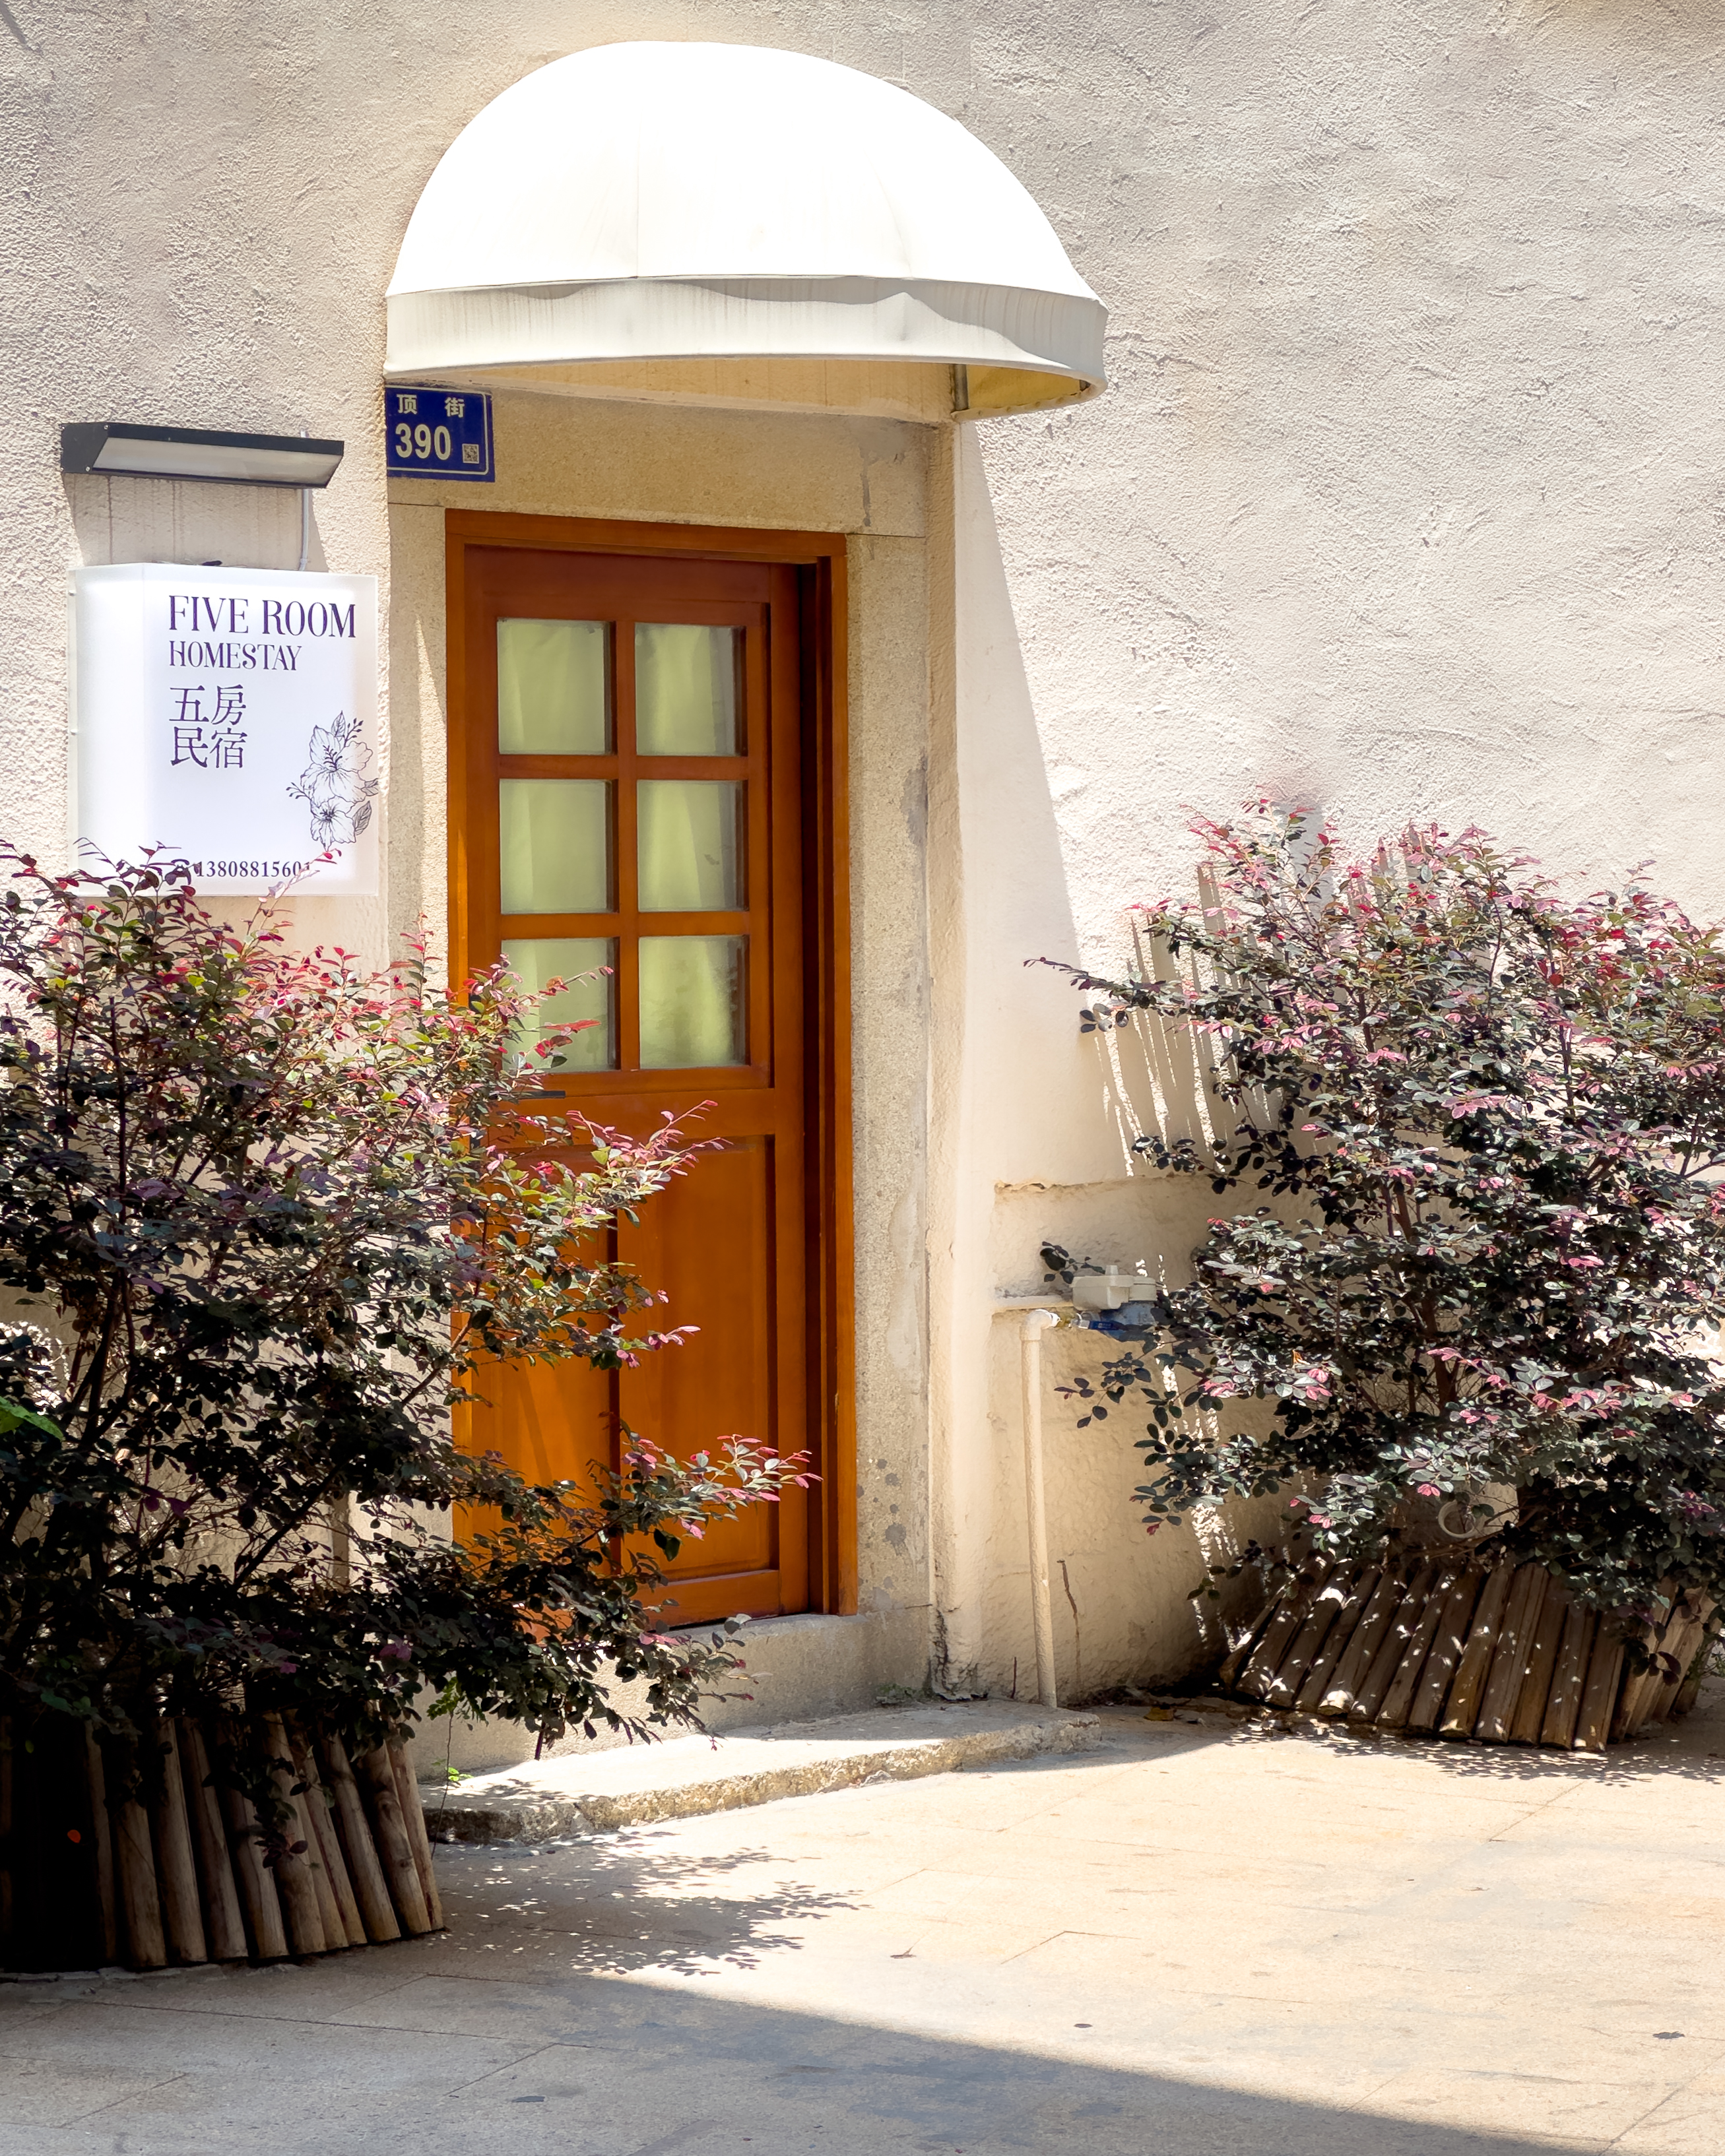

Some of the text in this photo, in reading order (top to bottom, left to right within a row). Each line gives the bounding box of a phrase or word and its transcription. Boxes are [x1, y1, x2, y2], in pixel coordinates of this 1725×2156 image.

[397, 394, 465, 418] 顶街
[395, 423, 451, 460] 390
[169, 596, 356, 638] FIVE ROOM
[169, 641, 302, 670] HOMESTAY
[169, 684, 247, 725] 五房
[170, 726, 248, 769] 民宿
